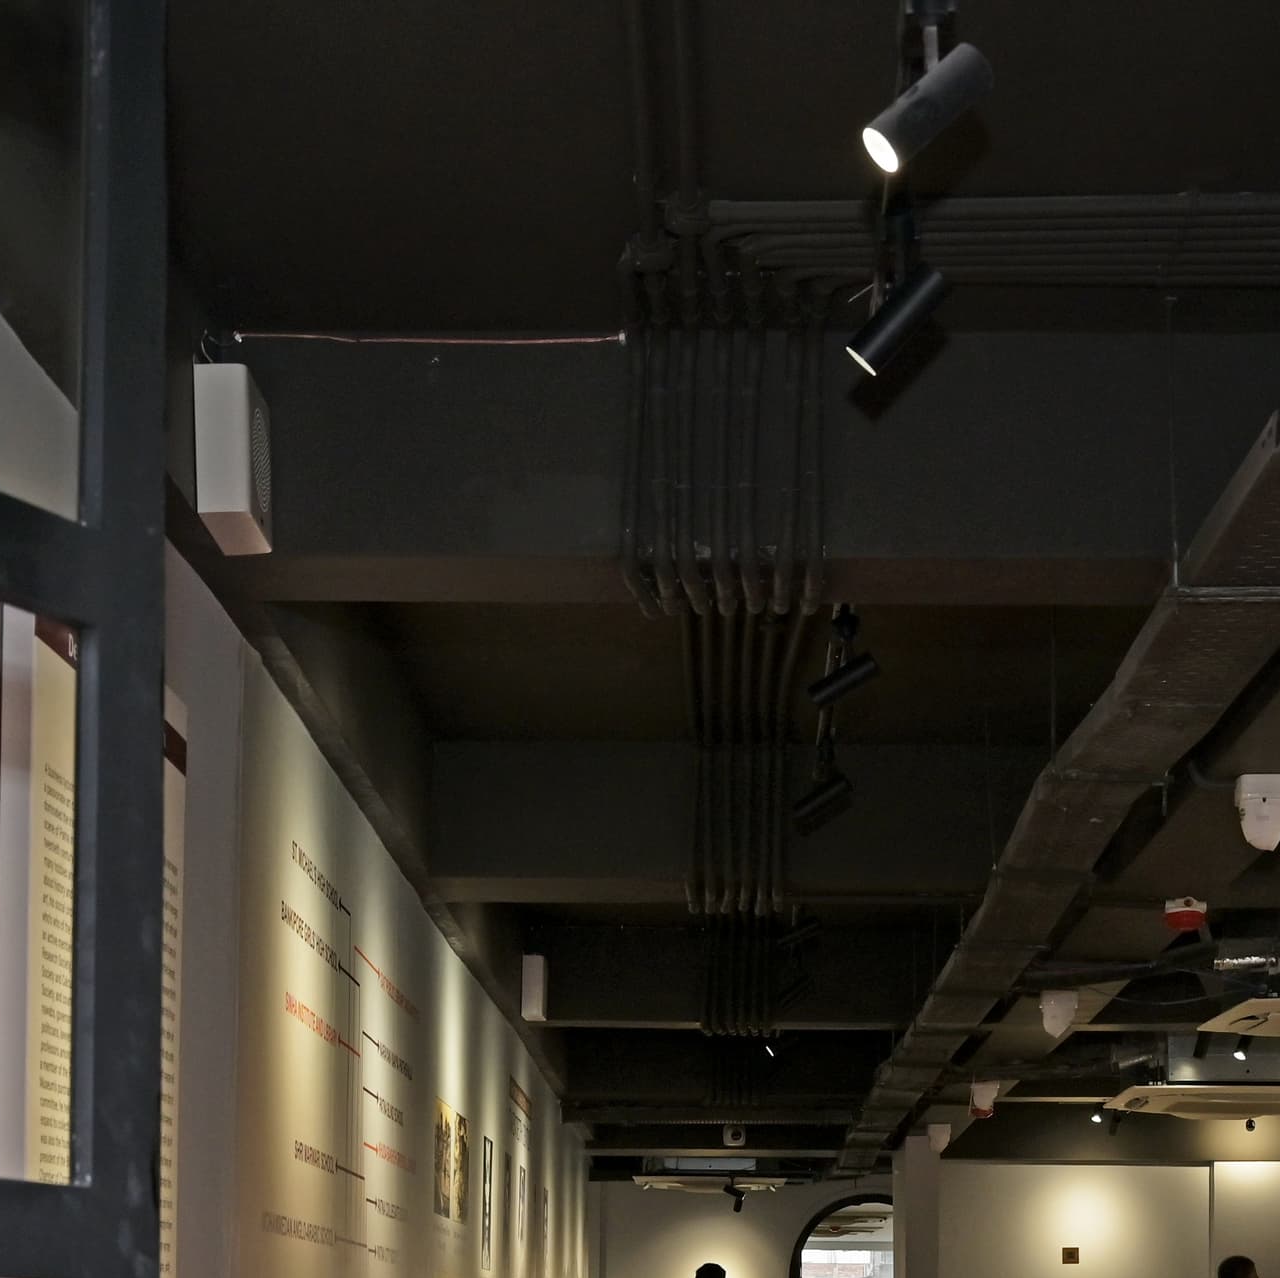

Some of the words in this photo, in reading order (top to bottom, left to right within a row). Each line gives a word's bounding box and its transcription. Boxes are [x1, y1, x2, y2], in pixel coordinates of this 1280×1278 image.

[317, 870, 326, 896] HIGH
[326, 879, 339, 911] SCHOOL
[281, 900, 304, 941] BANKIPORE
[316, 938, 325, 960] HIGH
[325, 944, 338, 973] SCHOOL
[298, 1001, 316, 1030] INSTITUTE
[316, 1012, 324, 1036] AND
[324, 1018, 338, 1045] LIBRARY
[304, 1144, 320, 1168] MARWARI
[320, 1149, 335, 1174] SCHOOL
